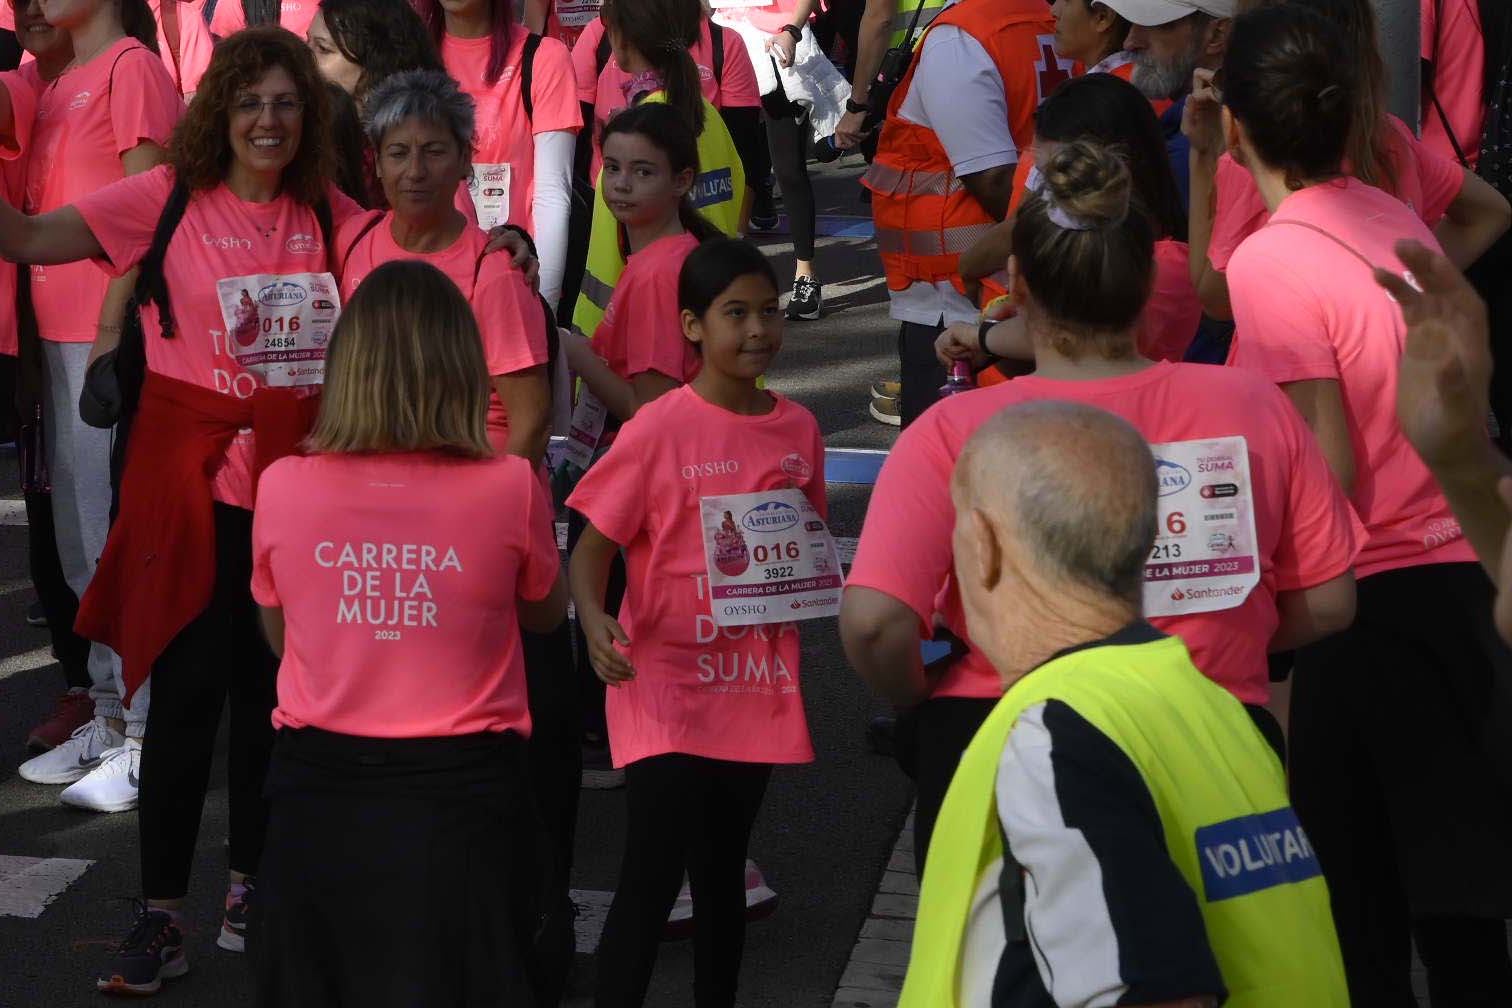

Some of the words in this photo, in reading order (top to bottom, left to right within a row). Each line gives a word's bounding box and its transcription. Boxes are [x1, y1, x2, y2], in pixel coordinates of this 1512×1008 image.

[262, 316, 301, 333] 016
[264, 337, 296, 349] 24854
[682, 459, 739, 481] OYSHO
[1197, 461, 1235, 473] SUMA
[747, 508, 799, 529] ASTURIANA
[314, 541, 464, 573] CARRERA
[752, 540, 801, 564] 016
[763, 565, 795, 581] 3922
[1155, 565, 1170, 577] LA
[1172, 563, 1209, 576] MUJER
[343, 570, 382, 597] DE
[394, 572, 433, 599] LA
[726, 585, 766, 597] CARRERA
[765, 583, 780, 594] DE
[780, 583, 792, 593] LA
[791, 580, 818, 591] MUJER
[1186, 584, 1245, 600] Santander
[336, 597, 439, 628] MUJER
[723, 603, 768, 617] OYSHO
[374, 630, 402, 641] 2023
[696, 652, 792, 684] SUMA
